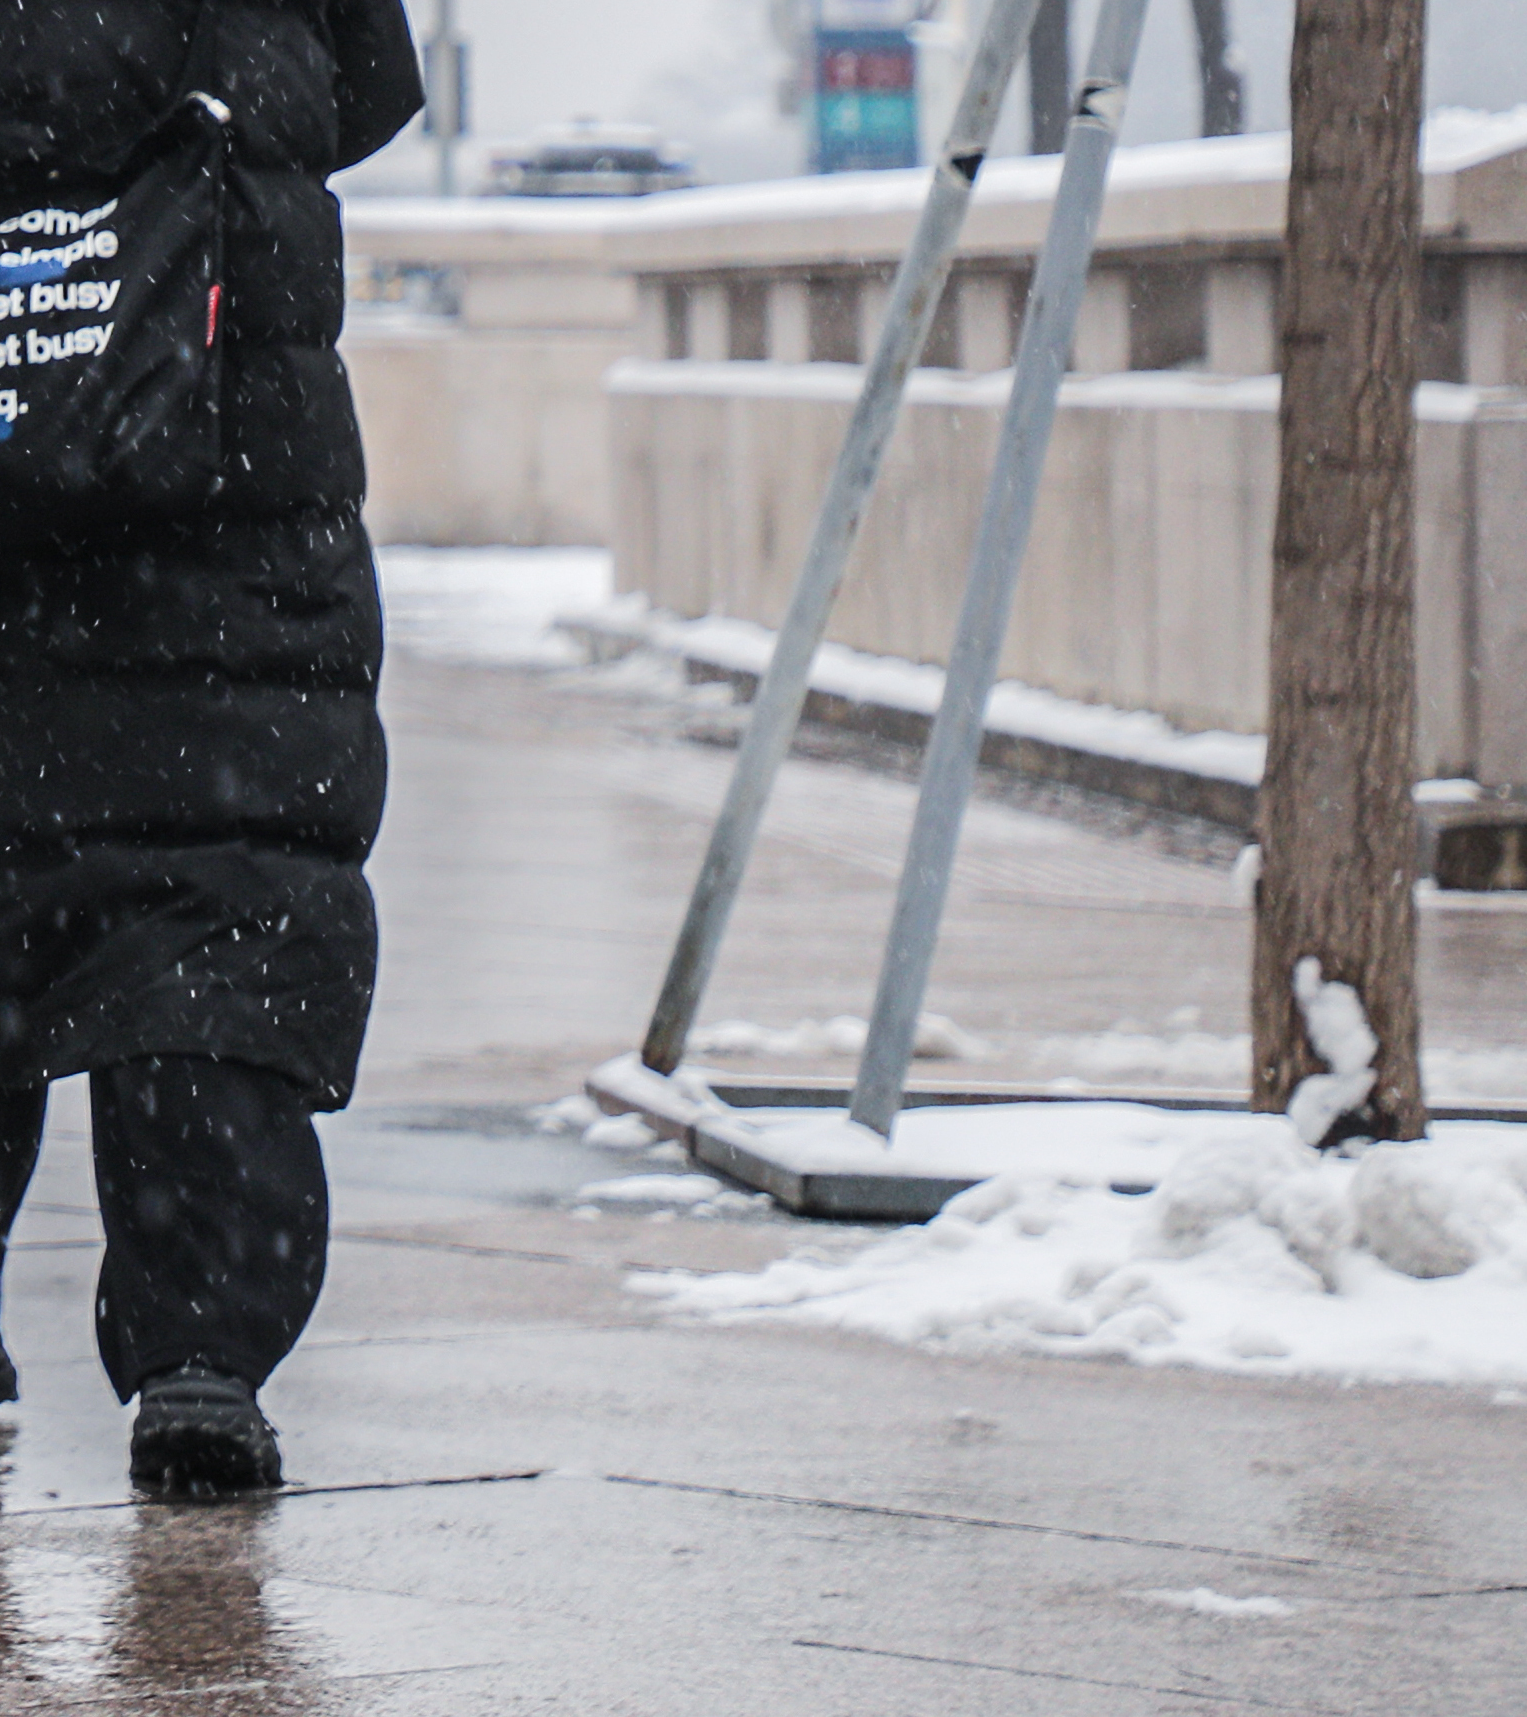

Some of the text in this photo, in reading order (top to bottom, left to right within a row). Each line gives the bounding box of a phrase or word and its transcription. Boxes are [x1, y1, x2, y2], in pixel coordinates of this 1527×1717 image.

[0, 230, 119, 269] simple
[30, 279, 121, 313] busy
[26, 321, 115, 365] busy
